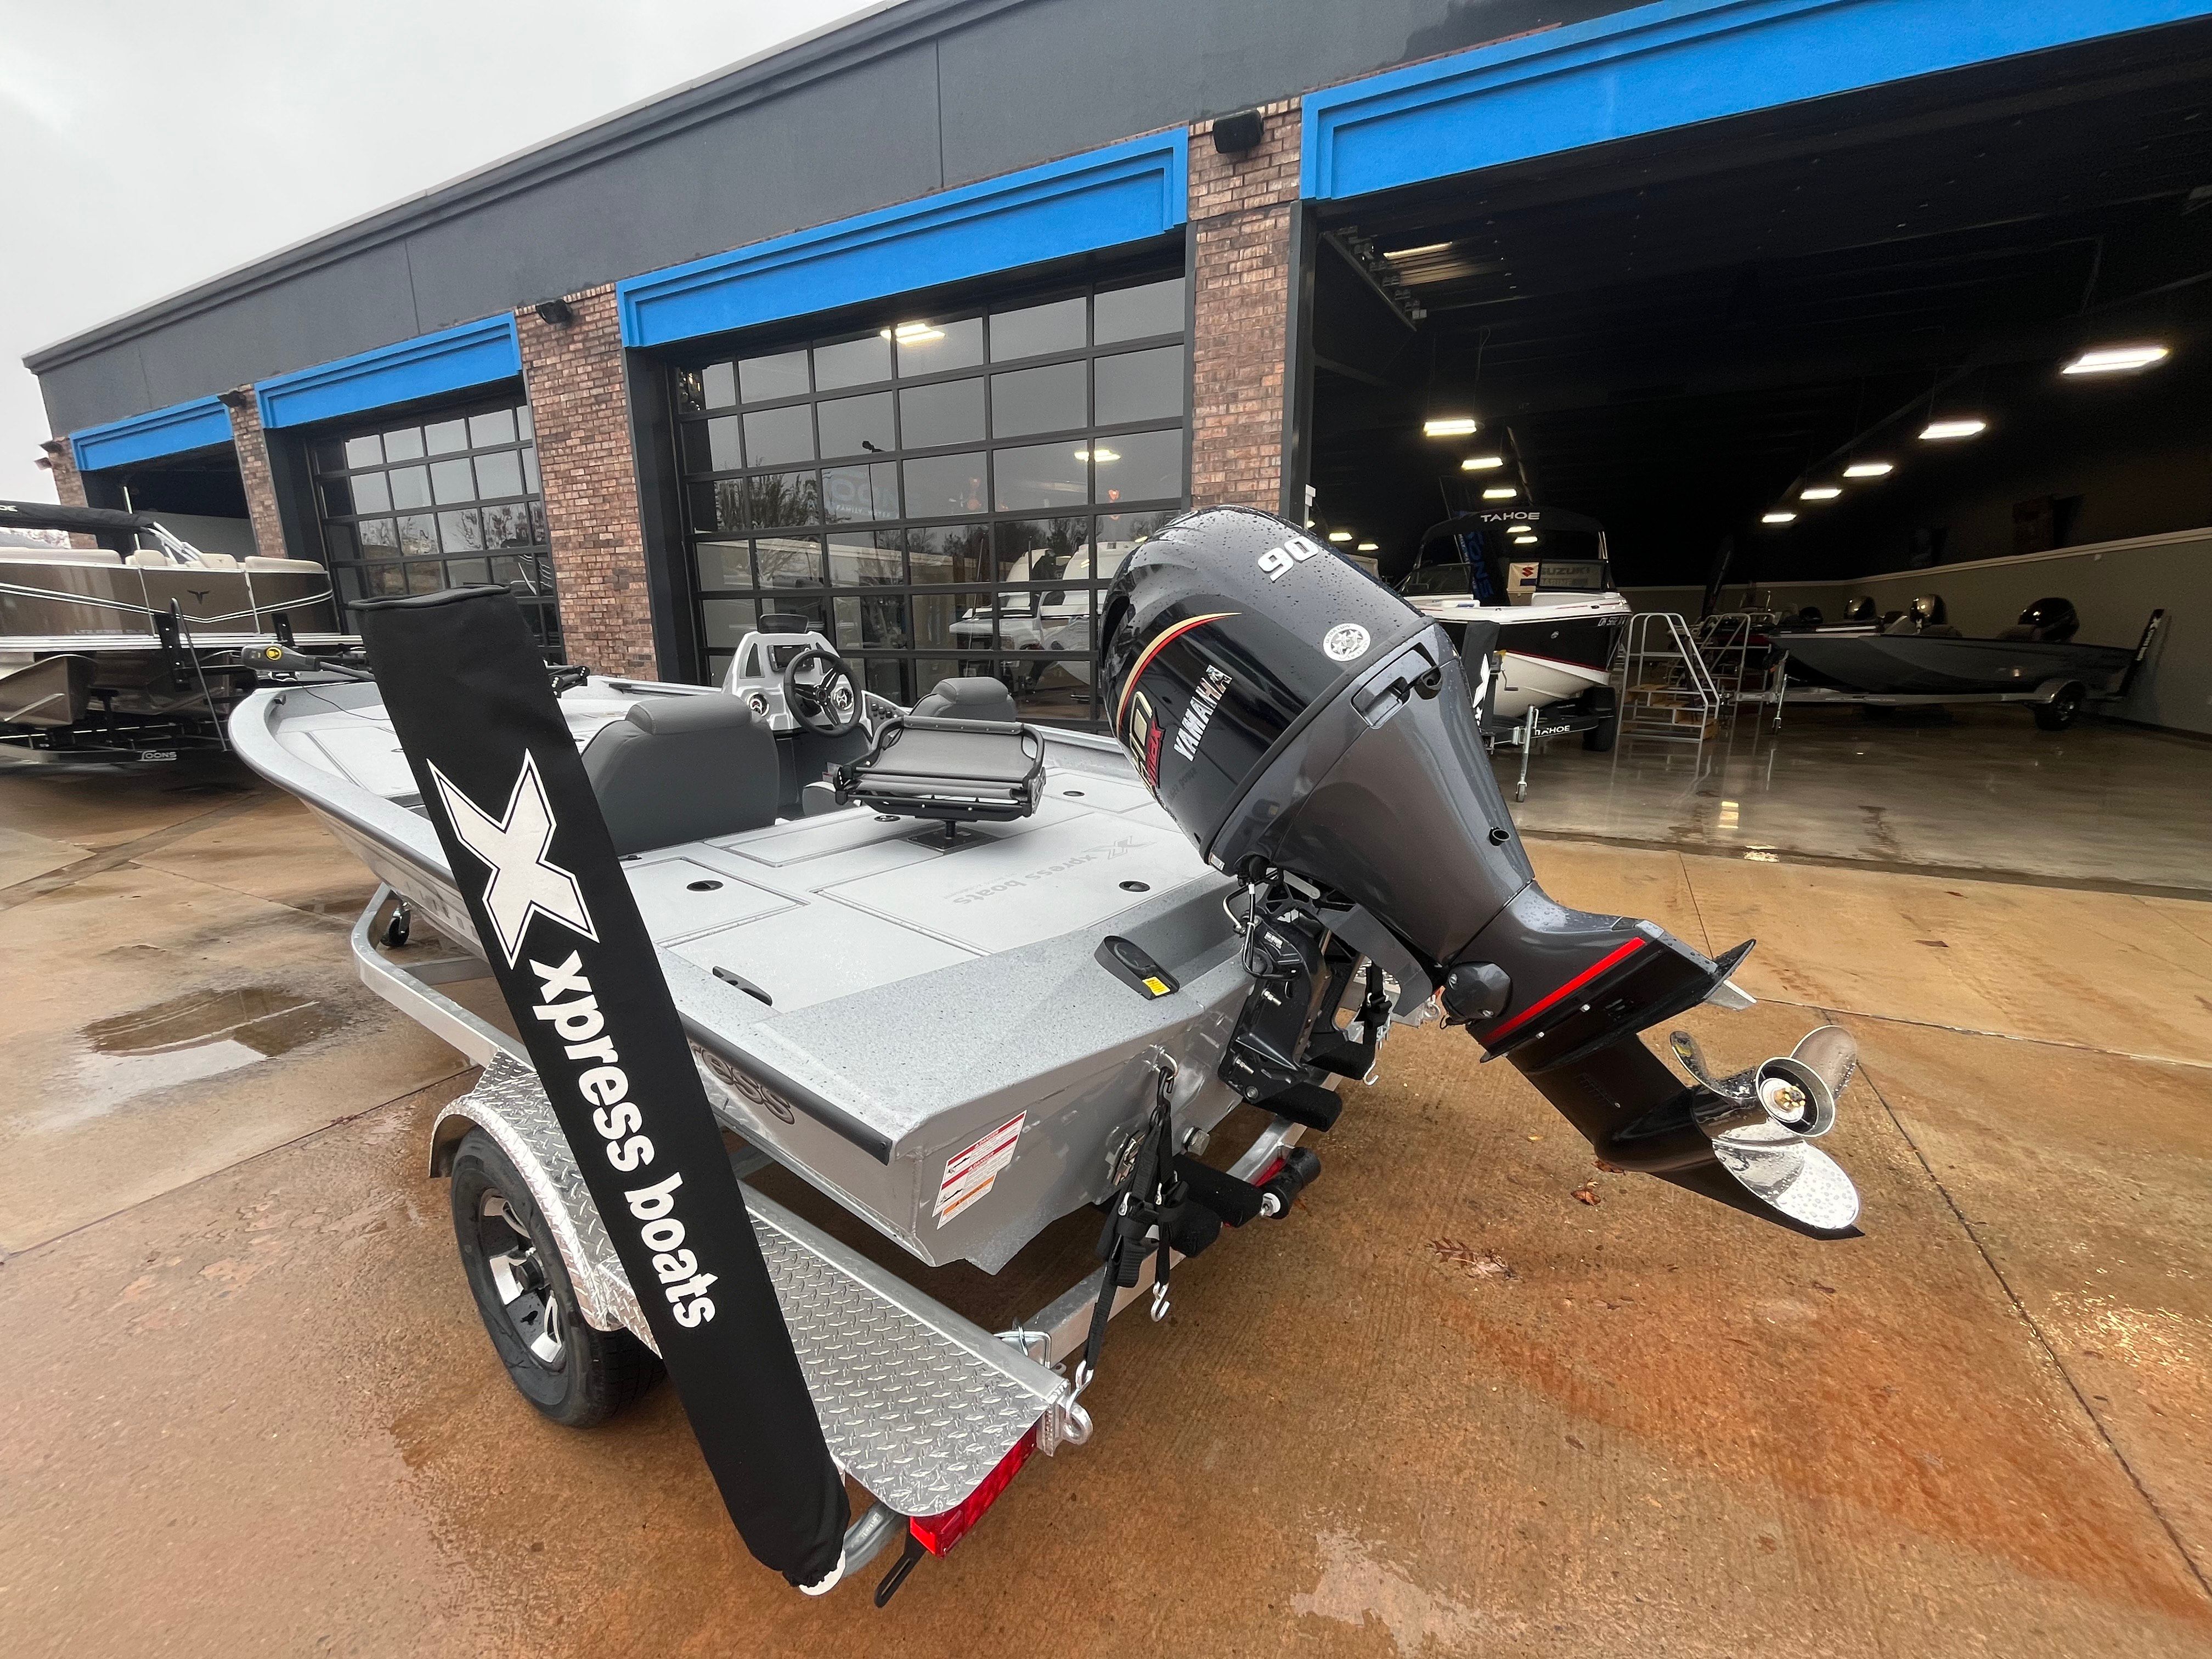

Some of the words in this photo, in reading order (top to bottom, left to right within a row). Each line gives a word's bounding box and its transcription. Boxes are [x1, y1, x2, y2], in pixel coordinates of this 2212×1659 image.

[1481, 512, 1540, 522] TAHOE
[1258, 535, 1319, 582] 90
[1173, 664, 1233, 761] YAMAHA
[1535, 724, 1571, 736] TAHOE
[1024, 854, 1097, 880] xpress
[953, 879, 1028, 905] boats
[529, 950, 656, 1172] xpress
[624, 1171, 719, 1329] boats
